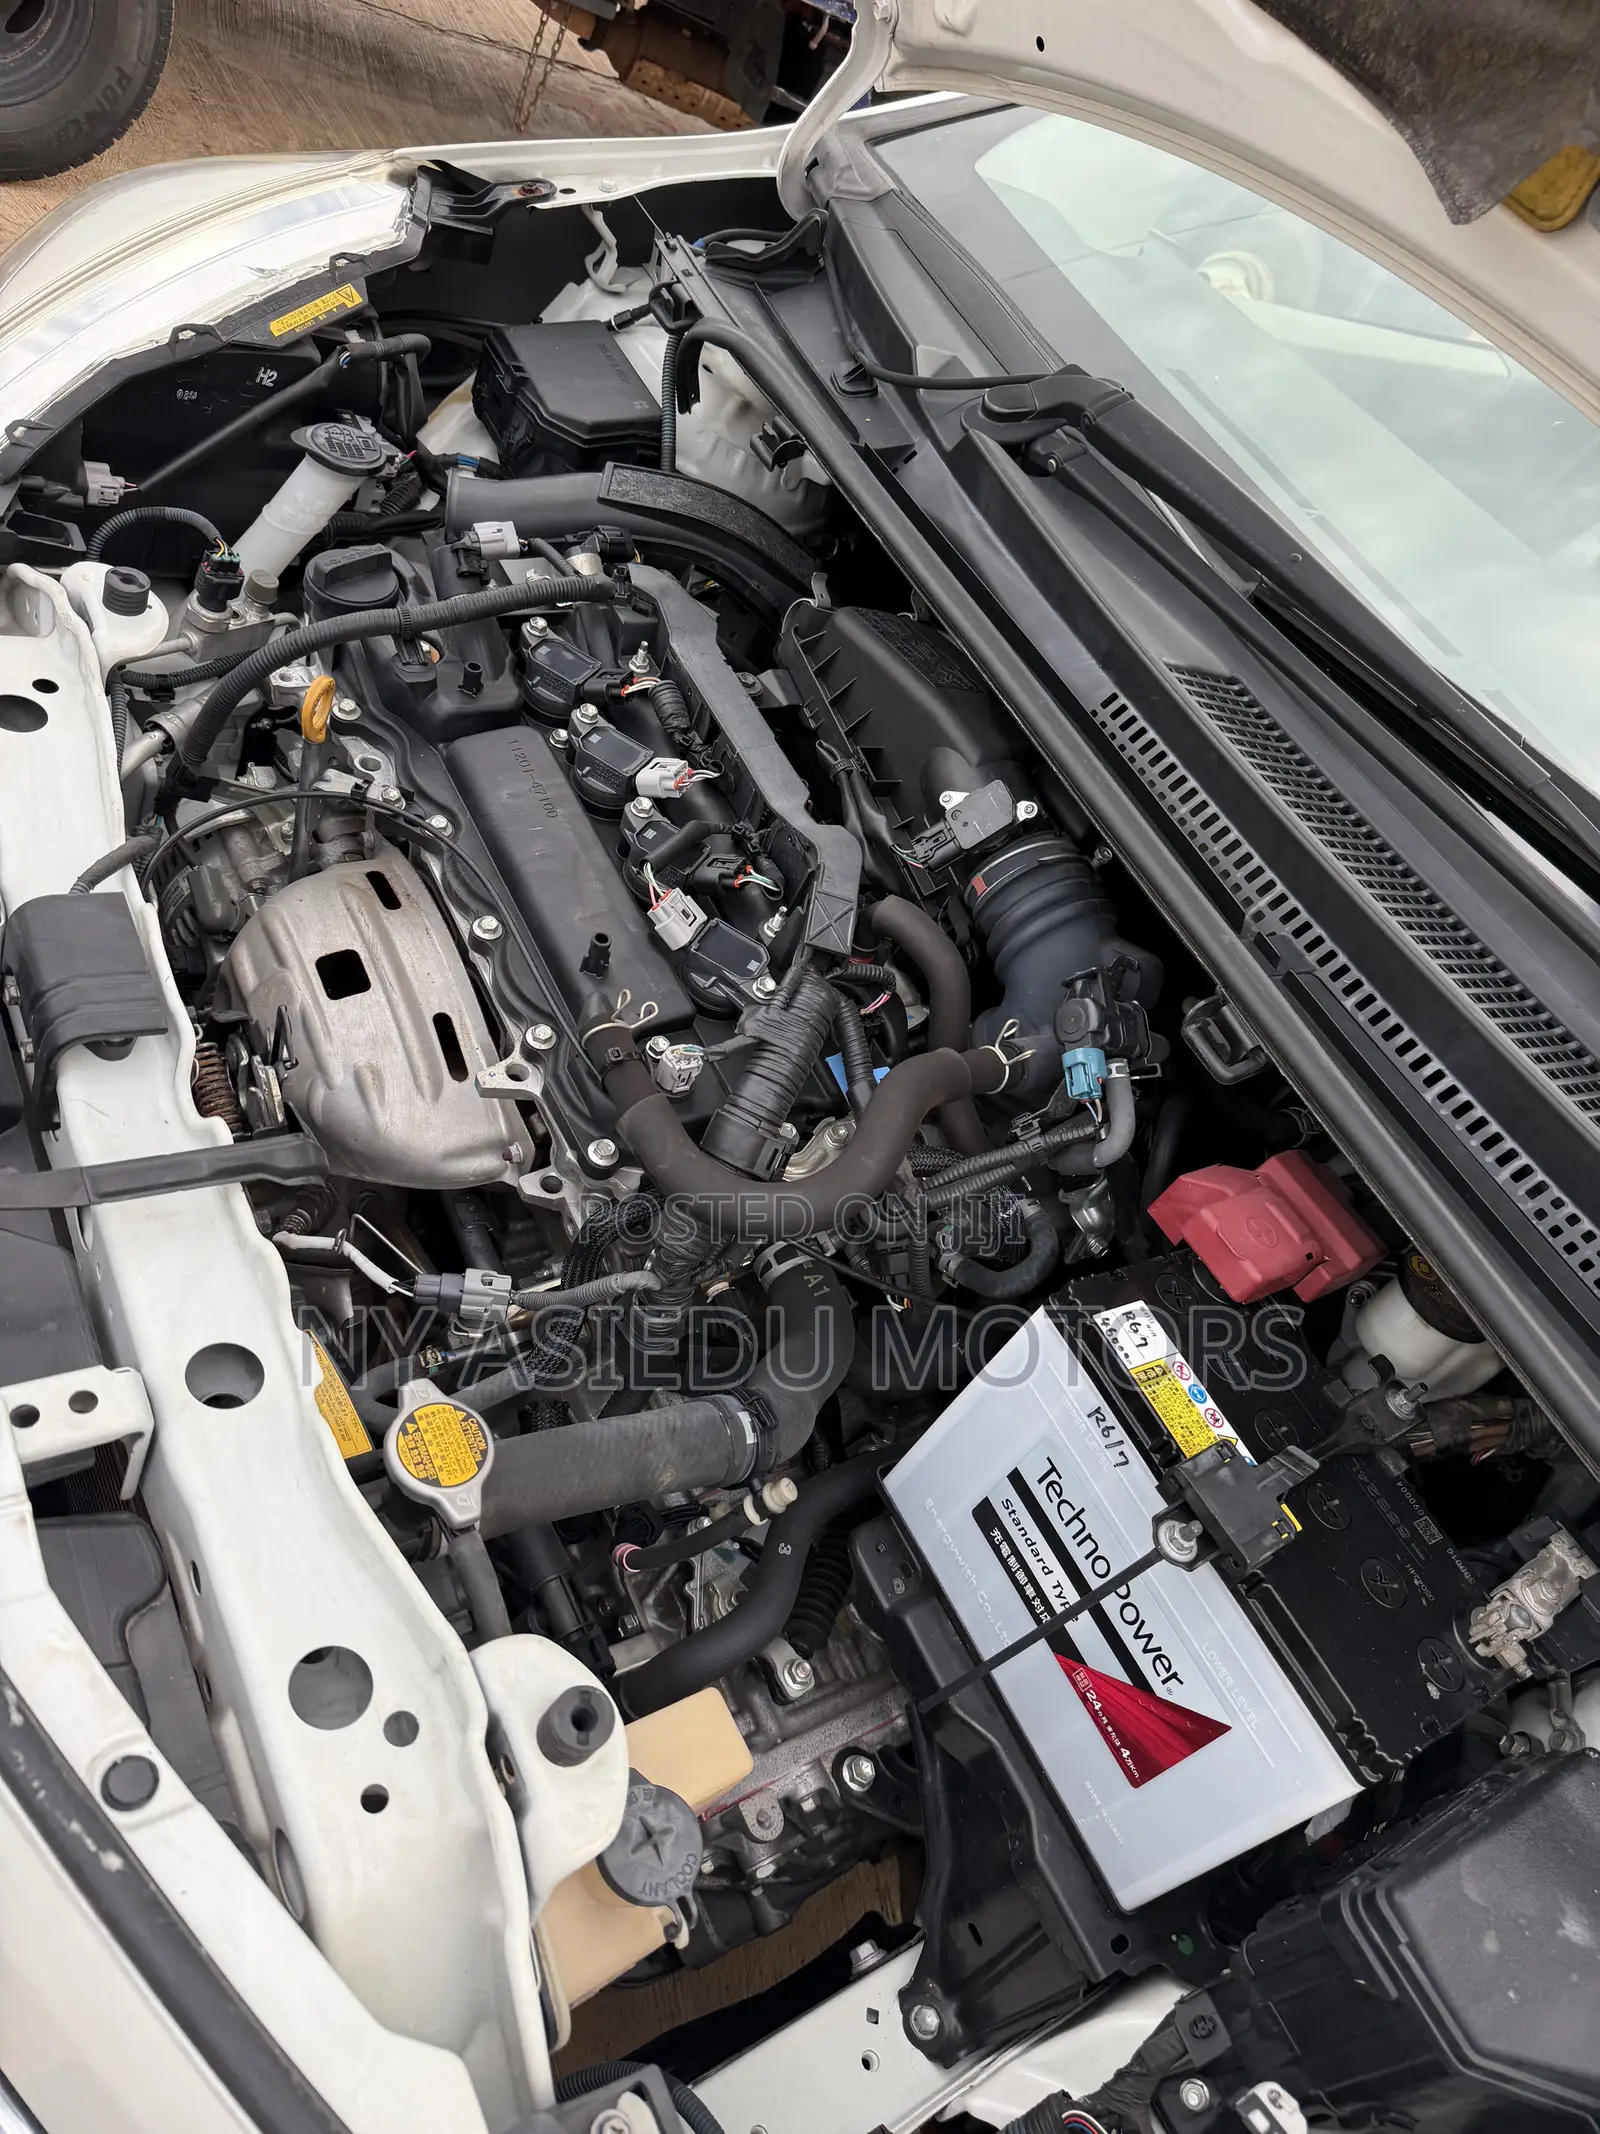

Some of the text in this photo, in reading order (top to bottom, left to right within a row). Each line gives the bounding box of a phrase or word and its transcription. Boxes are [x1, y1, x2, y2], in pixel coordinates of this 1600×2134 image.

[256, 366, 278, 387] H2
[460, 1421, 482, 1461] ATTENTION
[468, 1418, 487, 1450] CAUTION
[1000, 1498, 1054, 1576] Standard
[638, 1853, 697, 1896] COOLANT
